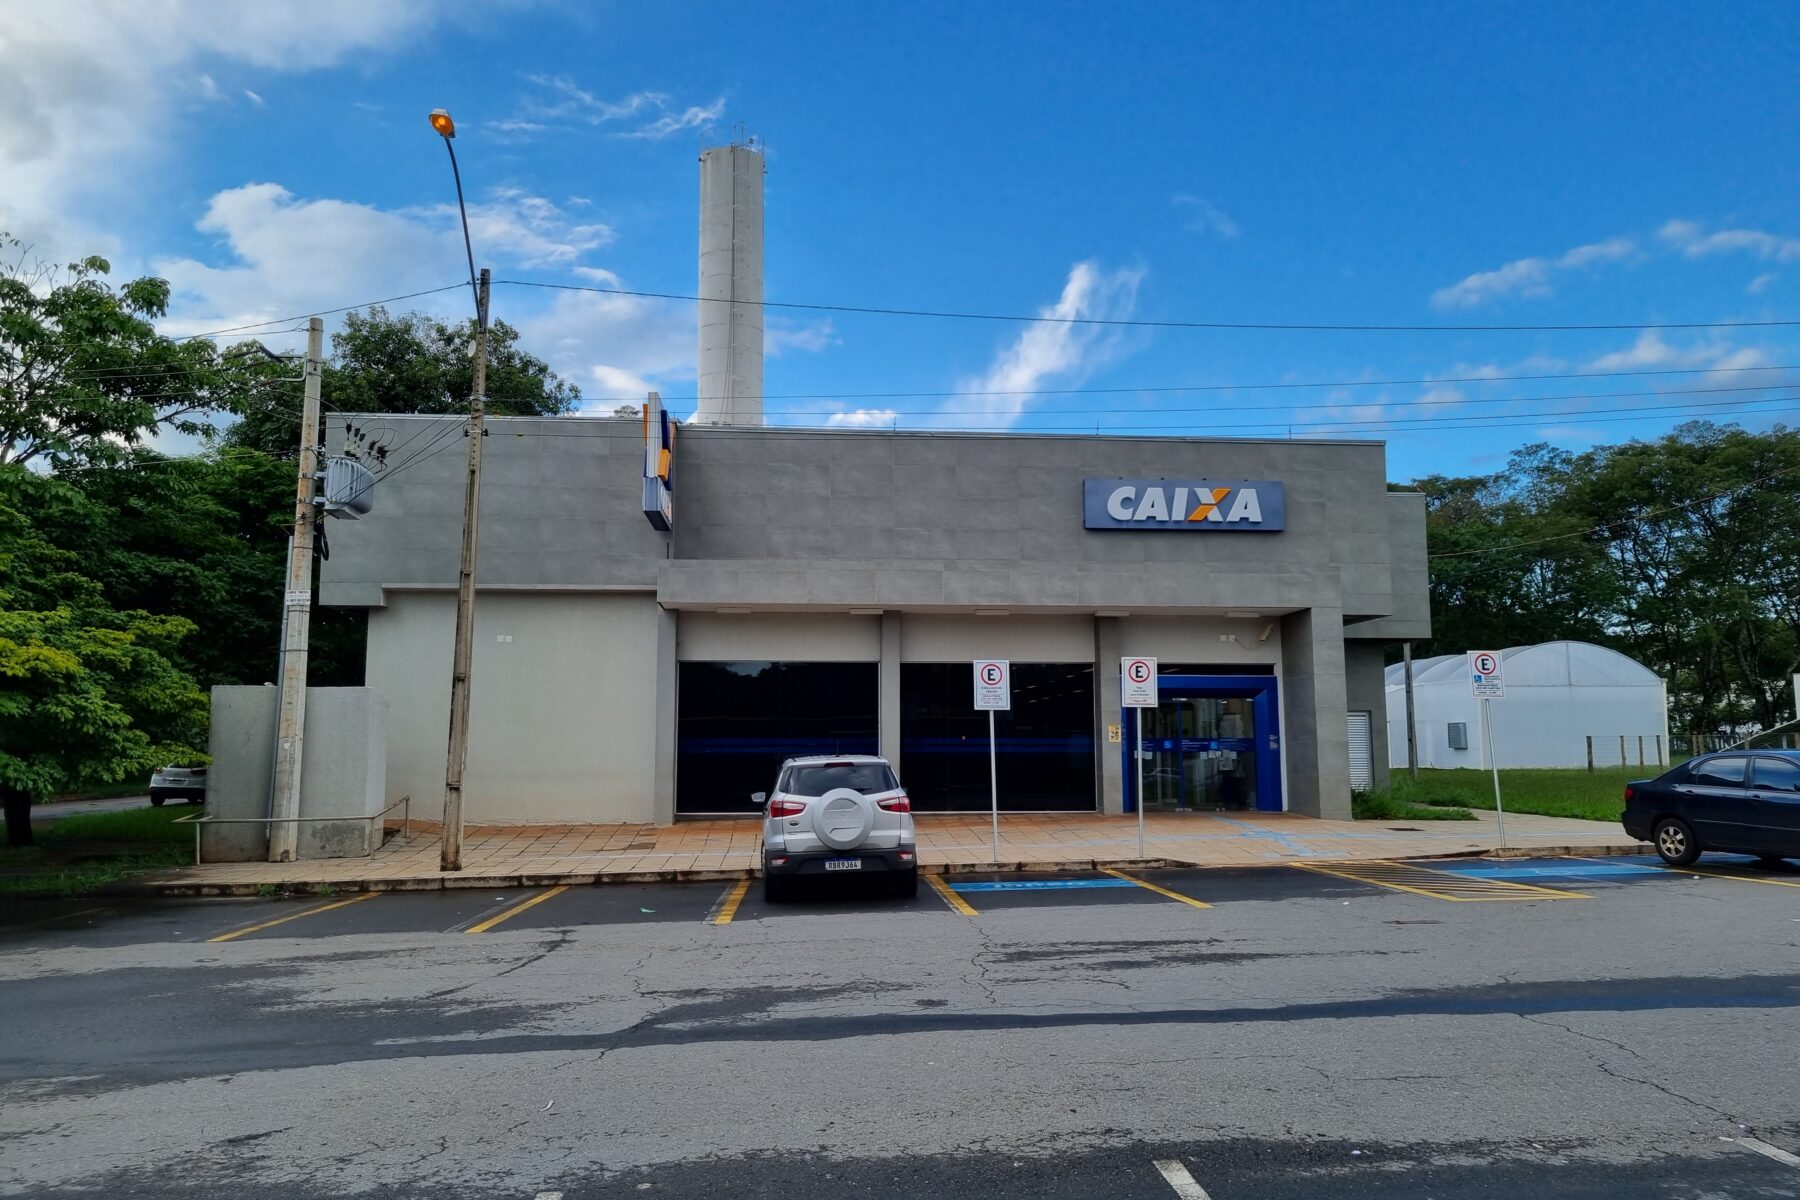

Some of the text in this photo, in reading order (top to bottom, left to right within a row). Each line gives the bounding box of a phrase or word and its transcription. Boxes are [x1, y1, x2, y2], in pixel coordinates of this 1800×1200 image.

[1107, 486, 1263, 523] CAIXA
[1481, 658, 1490, 671] E
[987, 668, 996, 681] E
[1136, 666, 1144, 678] E
